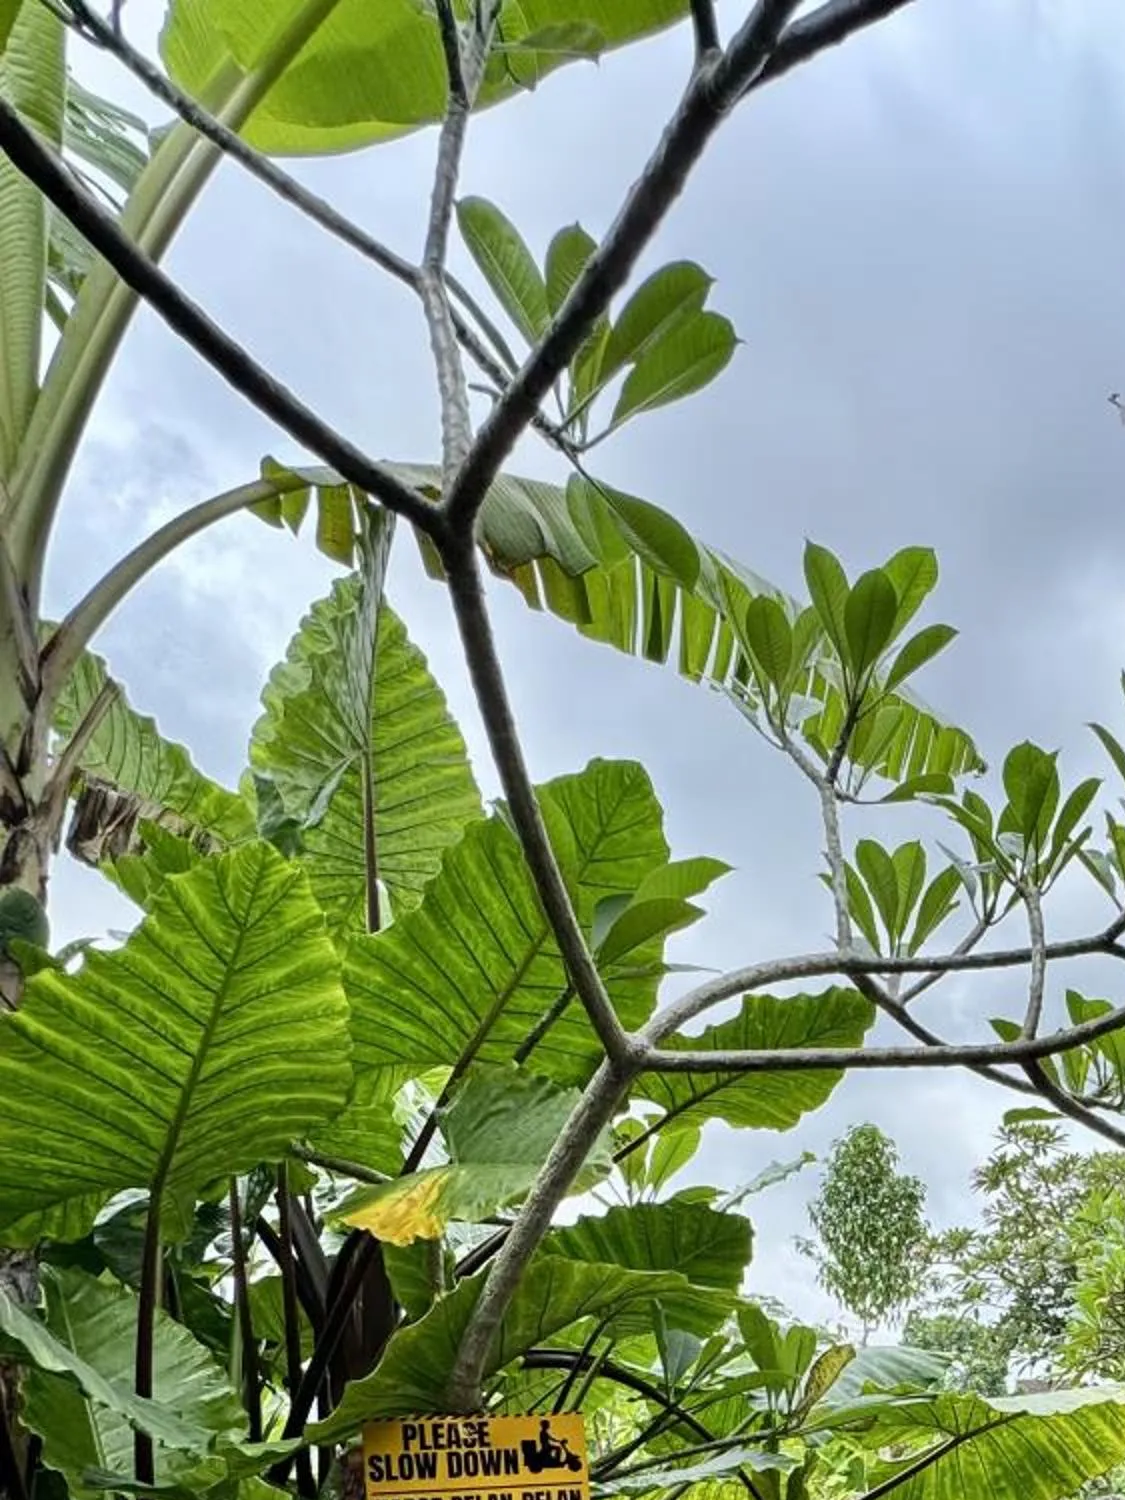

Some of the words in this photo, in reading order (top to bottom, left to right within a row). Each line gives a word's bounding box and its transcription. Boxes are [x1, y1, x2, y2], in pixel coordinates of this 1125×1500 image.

[402, 1422, 491, 1450] PLEASE
[368, 1453, 437, 1482] SLOW
[447, 1449, 519, 1478] DOWN
